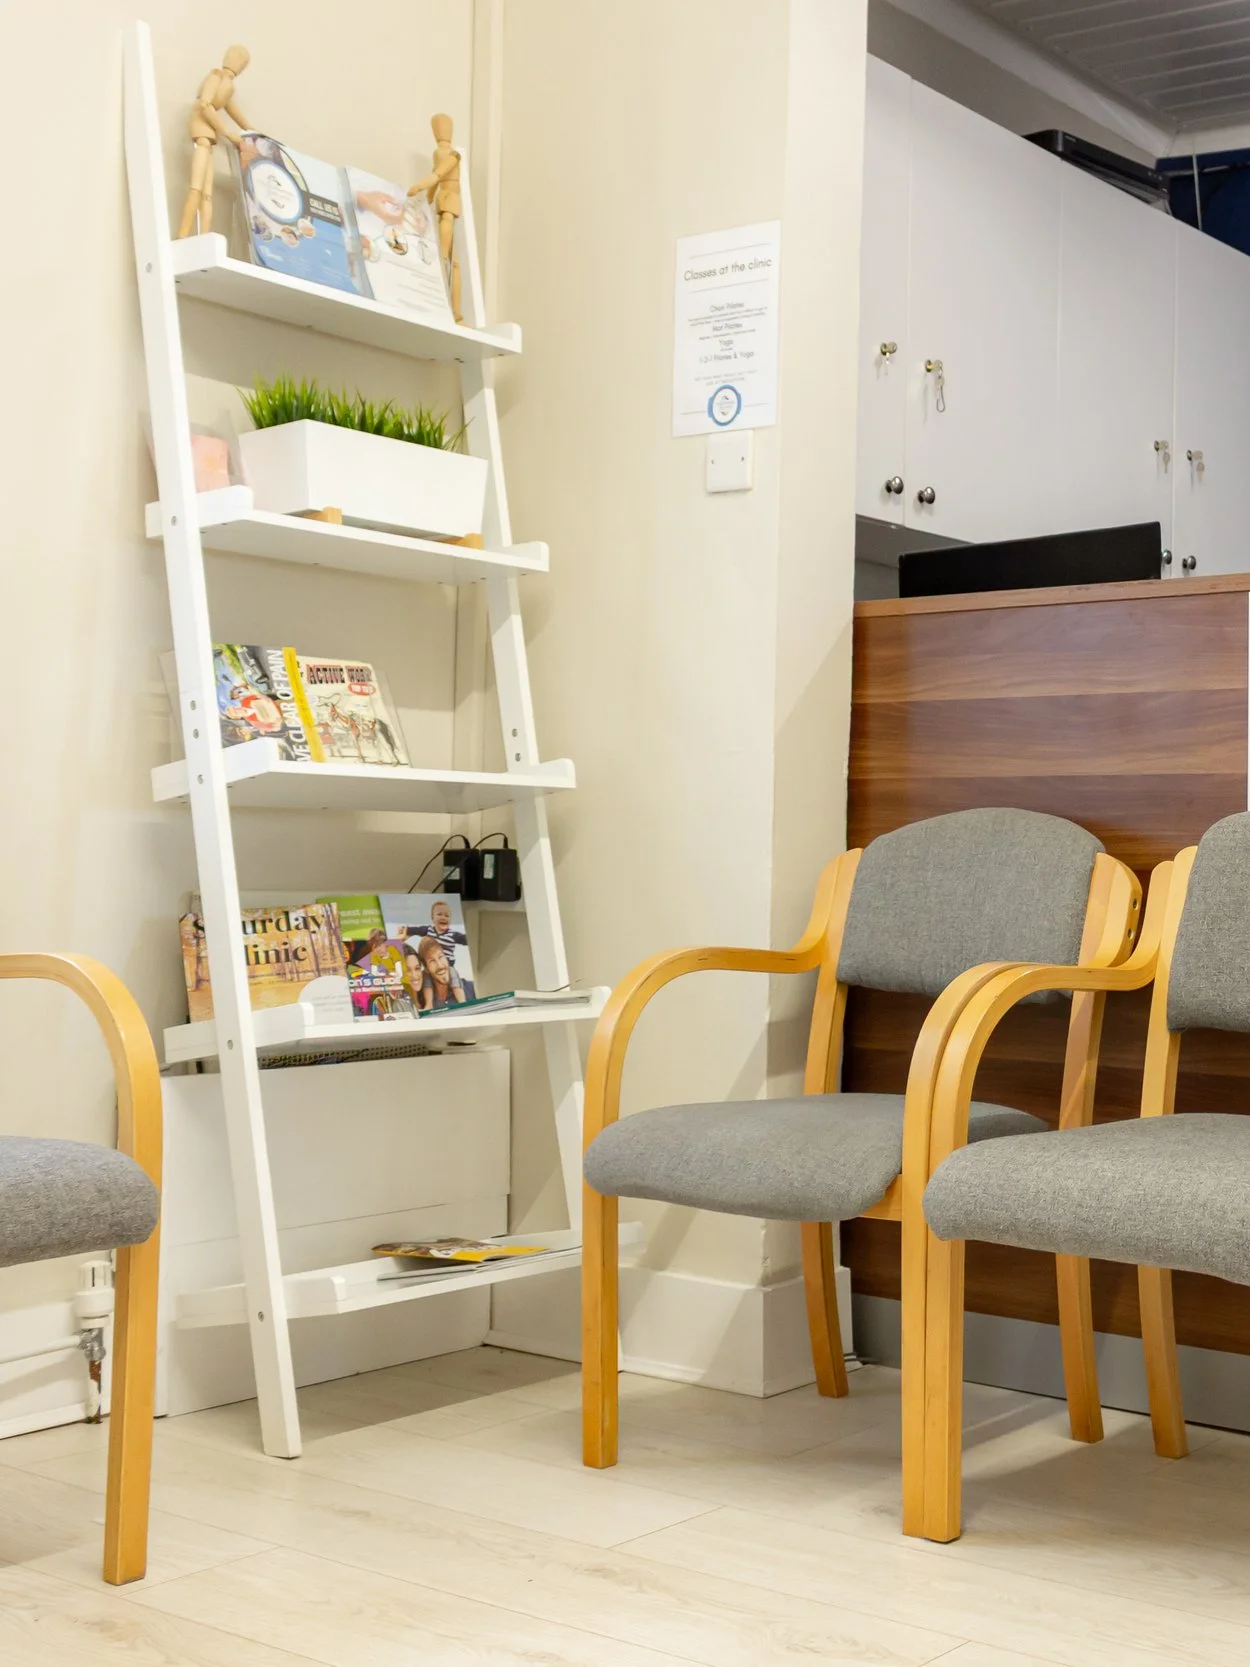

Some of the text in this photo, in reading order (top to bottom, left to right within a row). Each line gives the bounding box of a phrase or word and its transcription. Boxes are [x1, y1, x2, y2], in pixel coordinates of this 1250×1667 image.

[684, 256, 772, 281] Classes at the clinic
